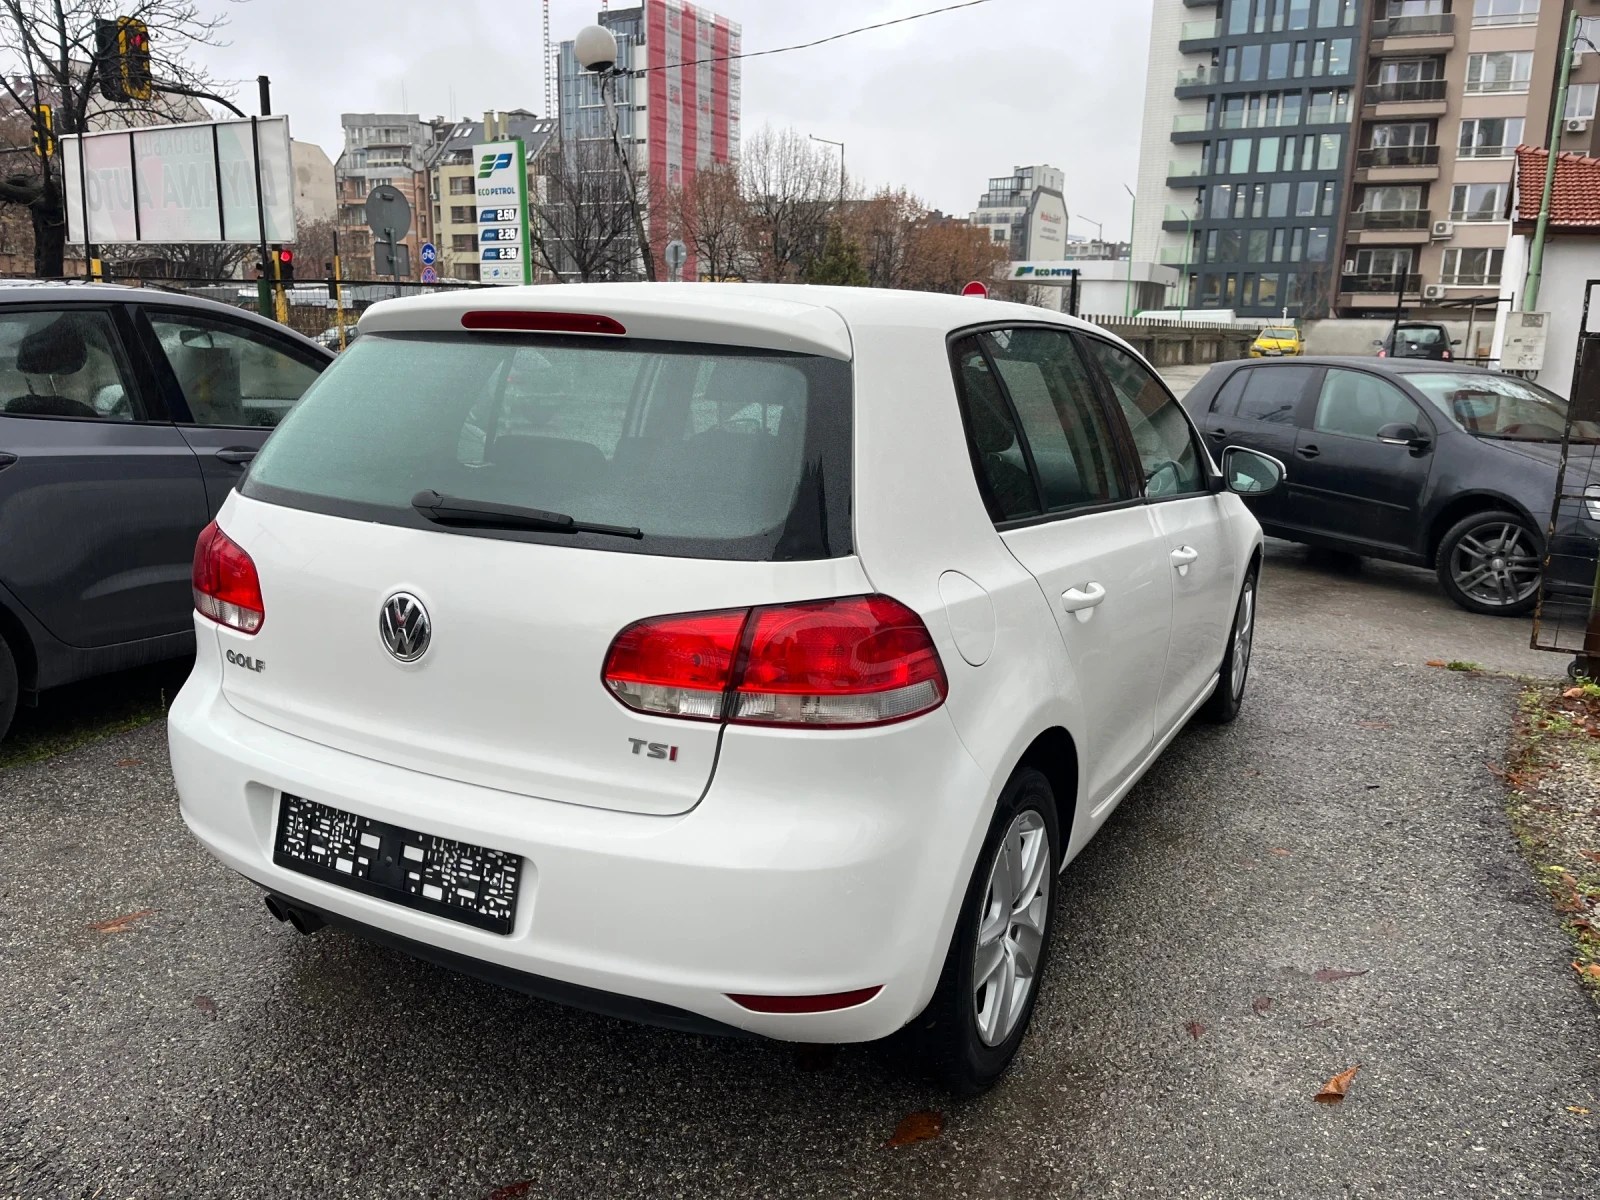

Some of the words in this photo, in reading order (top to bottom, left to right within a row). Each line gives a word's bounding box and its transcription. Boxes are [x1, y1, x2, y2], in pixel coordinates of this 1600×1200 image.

[478, 188, 490, 196] ECO
[490, 187, 515, 195] PETROL
[497, 209, 514, 220] 2.60
[498, 228, 515, 240] 2.28
[499, 248, 516, 259] 2.38
[1035, 268, 1050, 276] ECO
[1051, 268, 1081, 276] PETRL
[226, 649, 265, 672] GOLF
[628, 737, 678, 762] TSI
